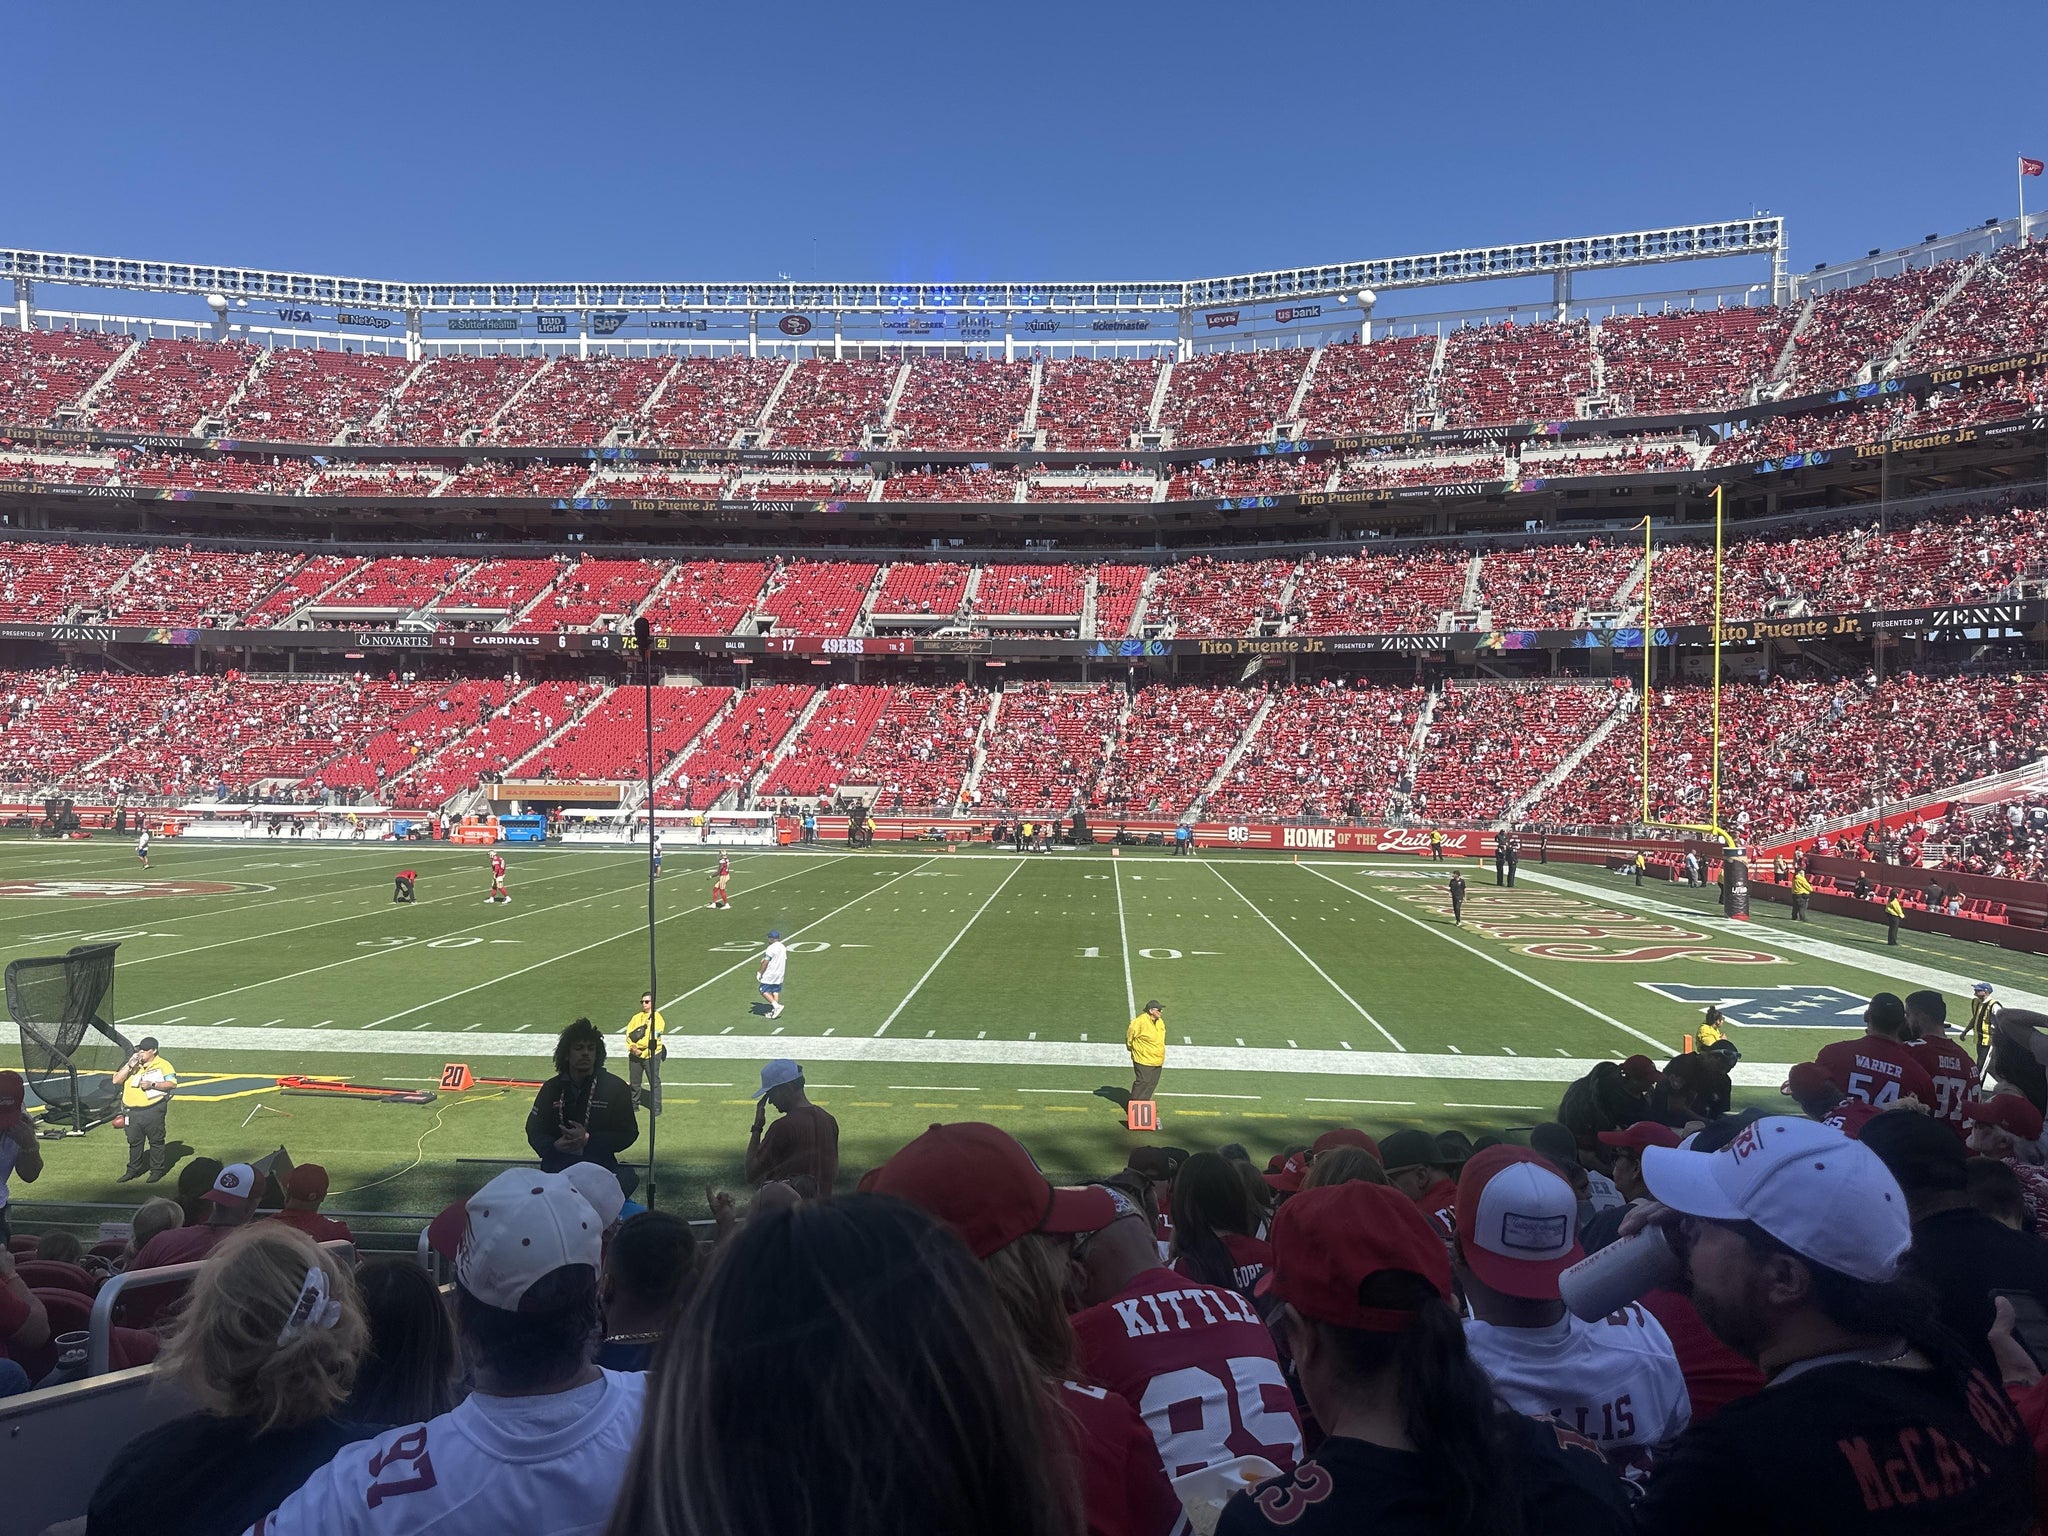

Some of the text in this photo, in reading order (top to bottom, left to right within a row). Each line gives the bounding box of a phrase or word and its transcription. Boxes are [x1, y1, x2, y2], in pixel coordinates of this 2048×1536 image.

[276, 309, 313, 323] VISA
[350, 314, 391, 329] NetApp
[541, 317, 562, 325] BUD
[457, 319, 517, 330] Sutter Health
[538, 325, 566, 333] LIGHT
[594, 319, 620, 331] SAP
[651, 321, 693, 329] UNITED
[1025, 321, 1061, 333] xfinity
[1092, 320, 1150, 332] ticketmaster
[1930, 366, 1963, 384] Tito
[1967, 358, 2027, 378] Puente
[4, 428, 31, 439] Tito
[34, 430, 80, 442] Puente
[83, 432, 101, 444] Jr.
[138, 437, 184, 448] ZENNI
[1333, 437, 1358, 449] Tito
[1361, 436, 1405, 448] Puente
[1408, 434, 1424, 446] Jr.
[1463, 428, 1510, 440] ZENNI
[1854, 442, 1887, 458] Tito
[1891, 434, 1951, 454] Puente
[1955, 428, 1977, 444] Jr.
[1985, 426, 2013, 436] PRESENTED
[656, 450, 679, 460] Tito
[682, 450, 721, 461] Puente
[724, 450, 739, 461] Jr.
[772, 451, 811, 461] ZENNI
[29, 482, 47, 495] Jr.
[88, 487, 135, 499] ZENNI
[1298, 494, 1324, 505] Tito
[1328, 492, 1374, 504] Puente
[1377, 491, 1394, 502] Jr.
[1434, 484, 1483, 497] ZENNI
[630, 500, 654, 510] Tito
[658, 500, 700, 510] Puente
[702, 500, 717, 511] Jr.
[752, 502, 794, 511] ZENNI
[1708, 605, 2021, 642] Tito Puente Jr. PRESENTED BY ZENNI
[51, 627, 117, 640] ZENNI
[372, 635, 428, 647] NOVARTIS
[449, 636, 455, 647] 3
[472, 636, 566, 648] CARDINALS 6
[602, 637, 608, 648] 3
[657, 638, 667, 648] 25
[725, 641, 745, 649] BALL ON
[782, 639, 794, 652] 17
[821, 638, 864, 653] 49ERS
[899, 642, 905, 652] 3
[1199, 639, 1233, 655] Tito
[1237, 639, 1299, 654] Puente
[1303, 638, 1326, 654] Jr.
[1381, 636, 1446, 650] ZENNI
[1284, 828, 1336, 848] HOME
[1338, 833, 1351, 845] OF
[1355, 833, 1377, 845] THE
[356, 935, 485, 949] 30
[708, 940, 832, 954] 20
[1074, 947, 1184, 960] 10
[1855, 1054, 1903, 1079] WARNER
[1938, 1055, 1962, 1071] BOSA
[441, 1065, 465, 1087] 20
[1847, 1071, 1901, 1109] 54
[1932, 1074, 1967, 1121] 97
[1131, 1103, 1152, 1127] 10
[1111, 1288, 1261, 1339] KITTLE
[1139, 1355, 1305, 1484] 85
